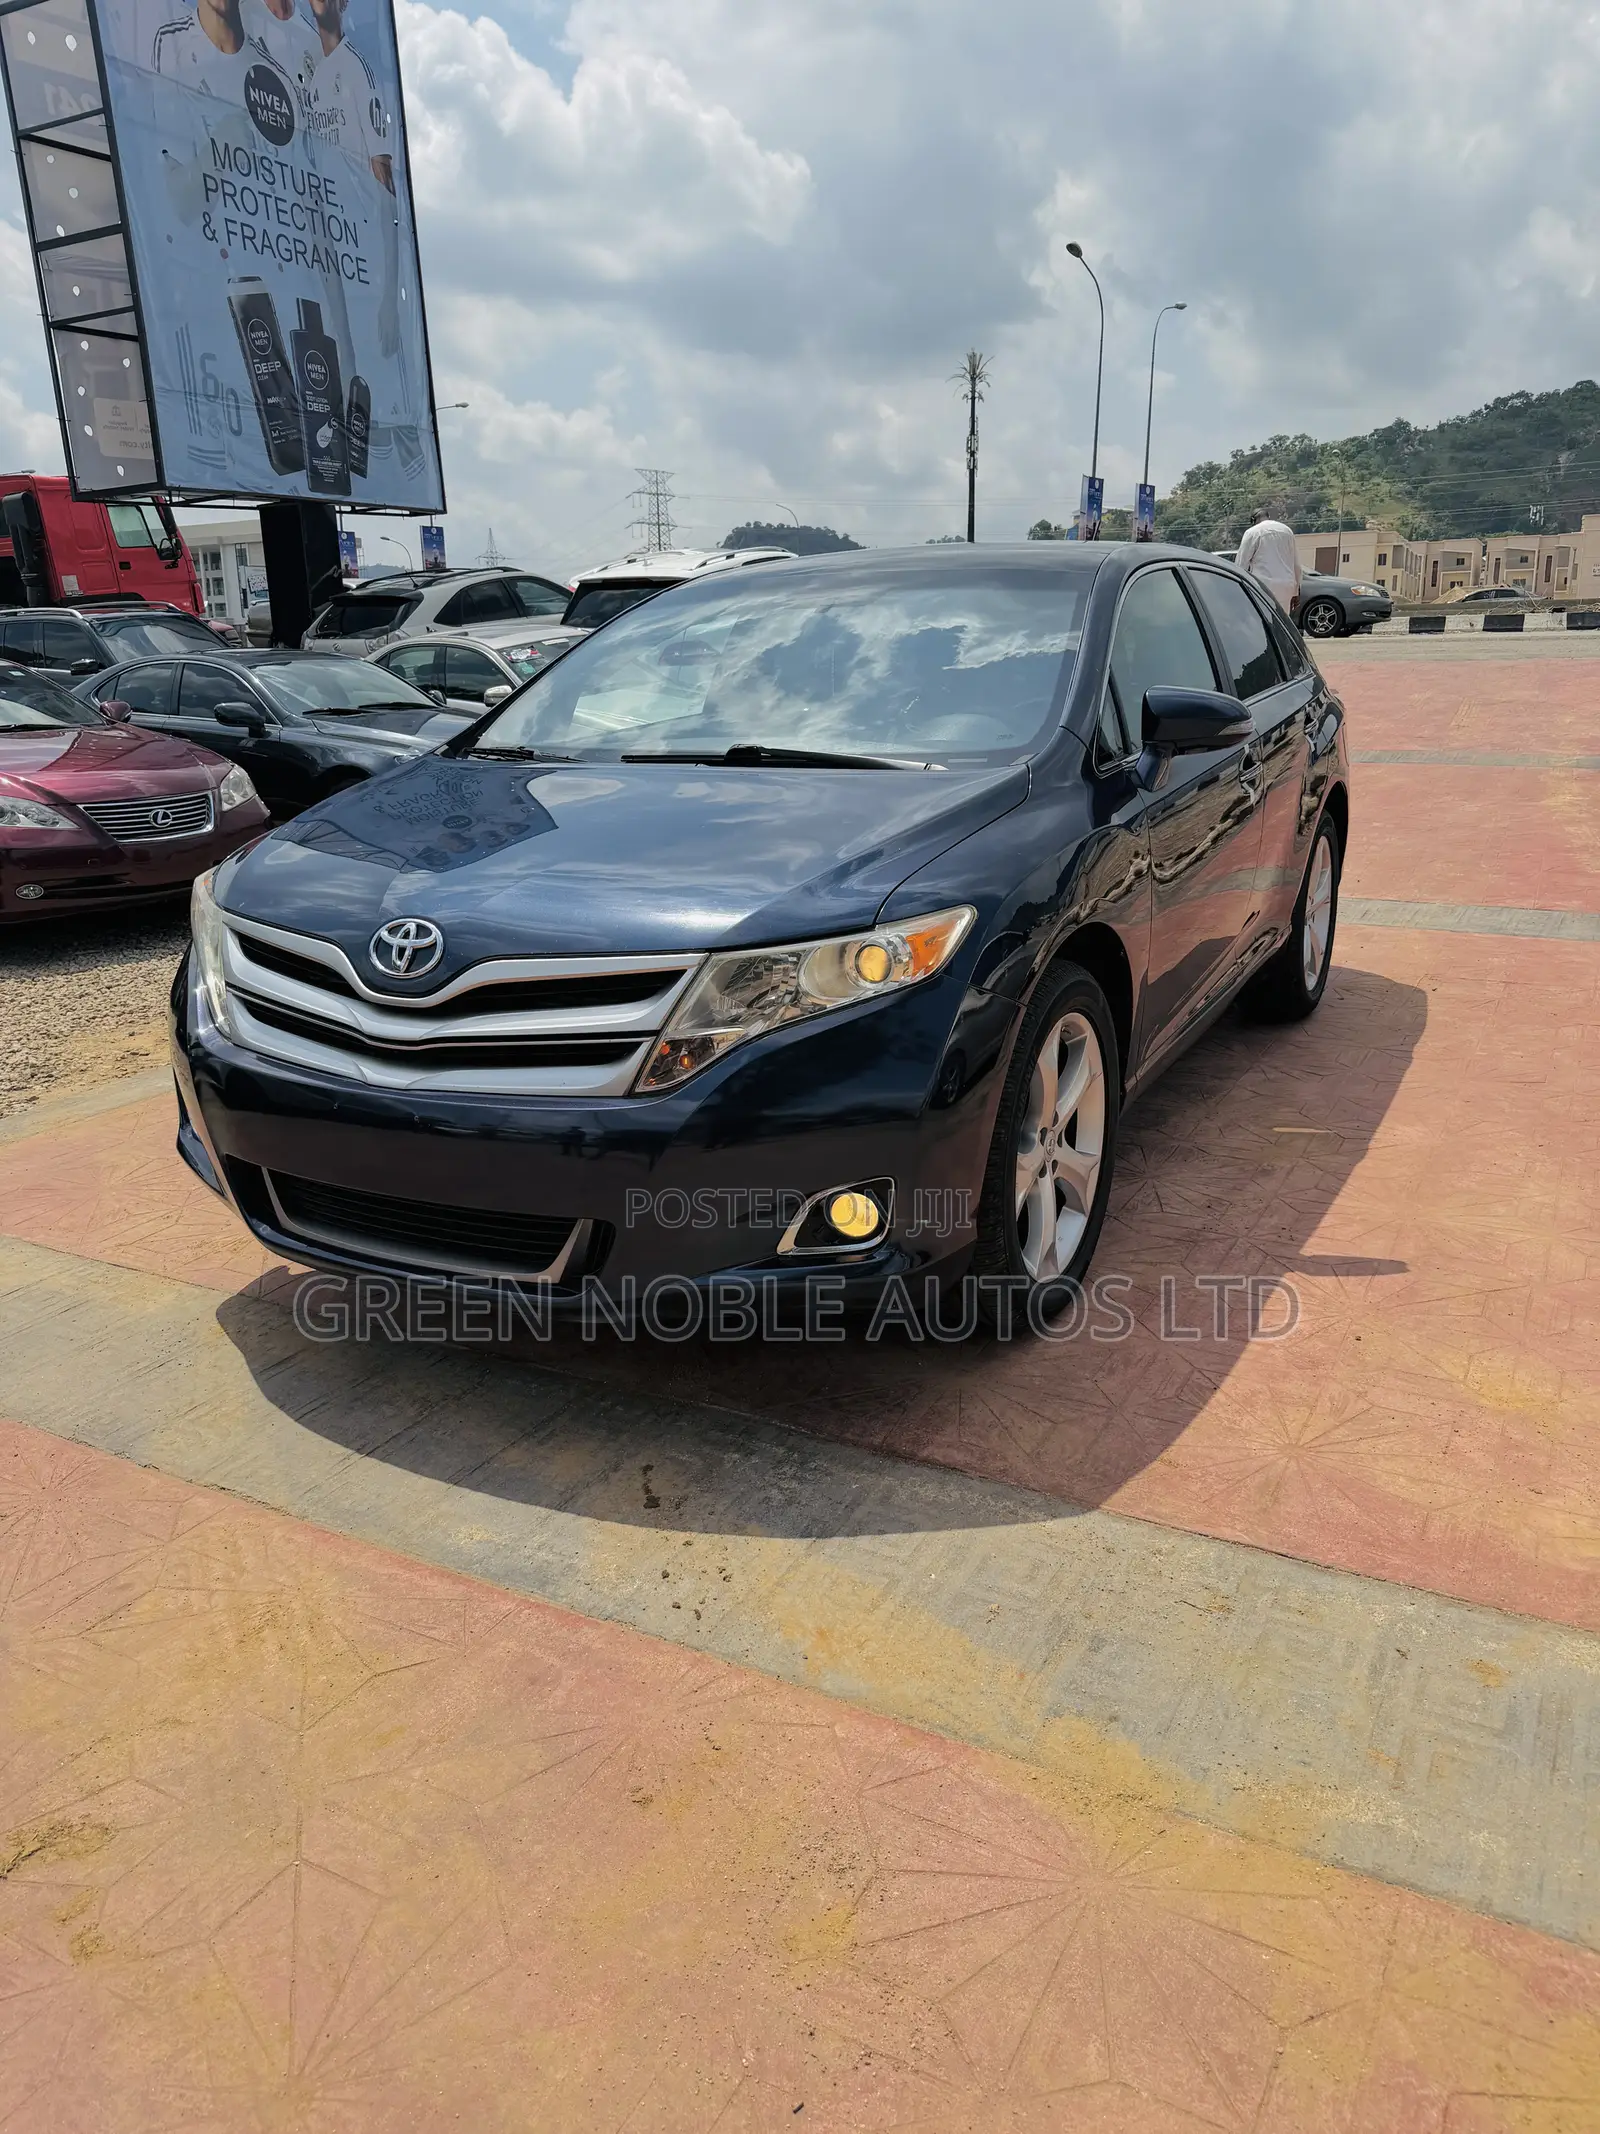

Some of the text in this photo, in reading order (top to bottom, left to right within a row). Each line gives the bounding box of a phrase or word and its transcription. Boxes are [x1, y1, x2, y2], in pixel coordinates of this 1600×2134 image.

[249, 85, 290, 116] NIVEA
[257, 107, 287, 130] MEN
[210, 137, 345, 214] MOISTURE,
[202, 172, 359, 248] PROTECTION
[202, 211, 371, 285] & FRAGRANCE
[250, 331, 269, 339] NIVEA
[254, 360, 282, 374] DEEP
[306, 363, 327, 374] NIVEA
[310, 372, 325, 380] MEN
[307, 401, 331, 413] DEEP
